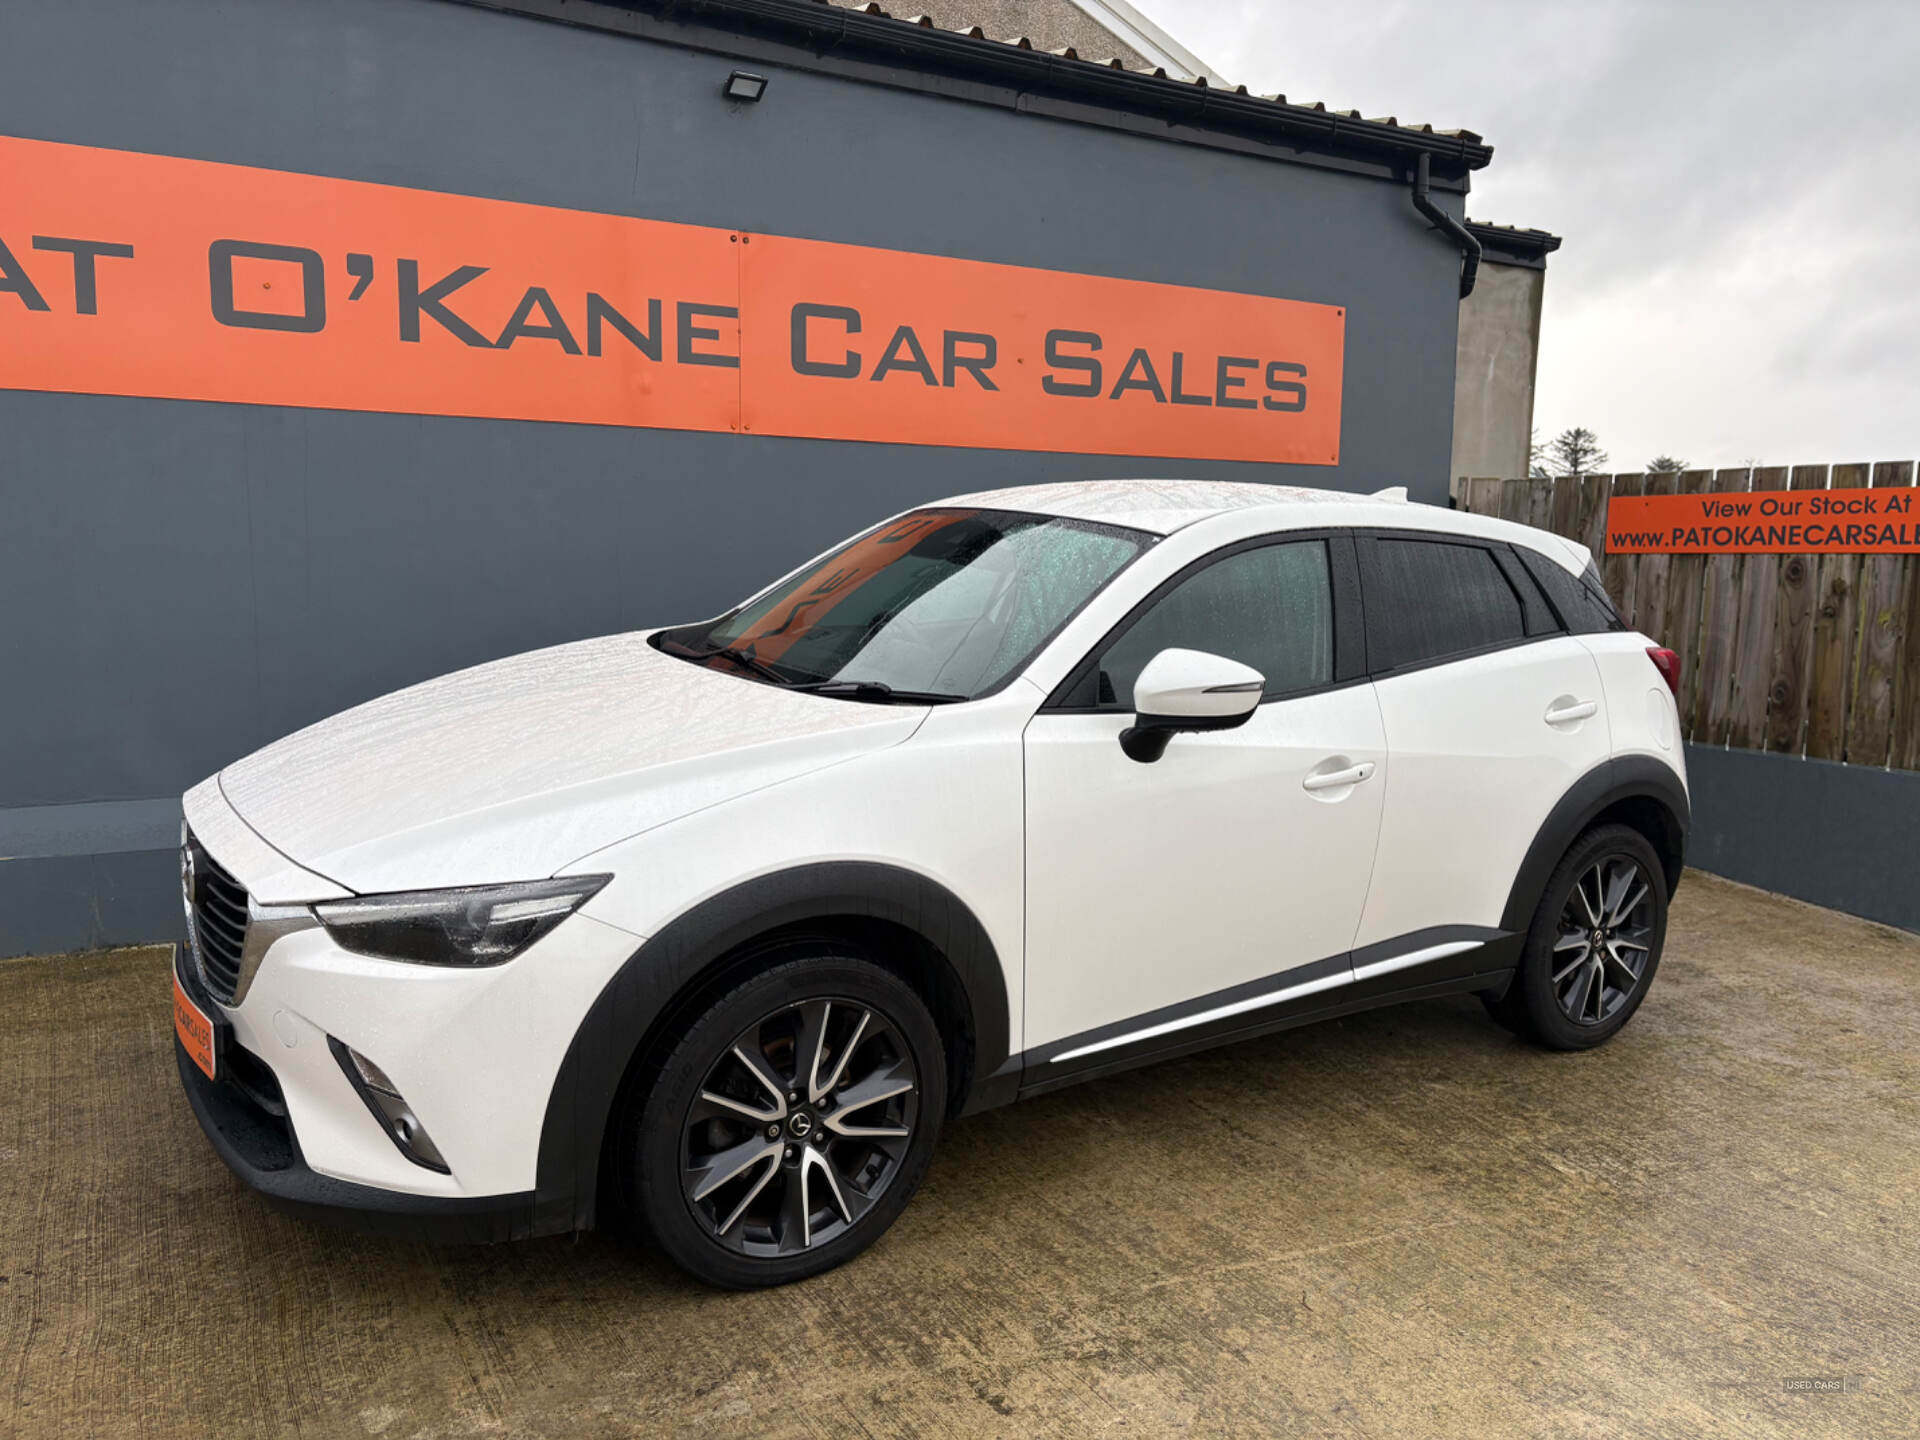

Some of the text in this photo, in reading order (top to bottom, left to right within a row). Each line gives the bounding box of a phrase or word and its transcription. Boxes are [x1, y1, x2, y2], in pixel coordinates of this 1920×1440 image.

[209, 240, 740, 368] O'KANE
[791, 303, 1001, 391] CAR
[1042, 329, 1308, 412] SALES
[1702, 494, 1912, 518] View Our Stock At
